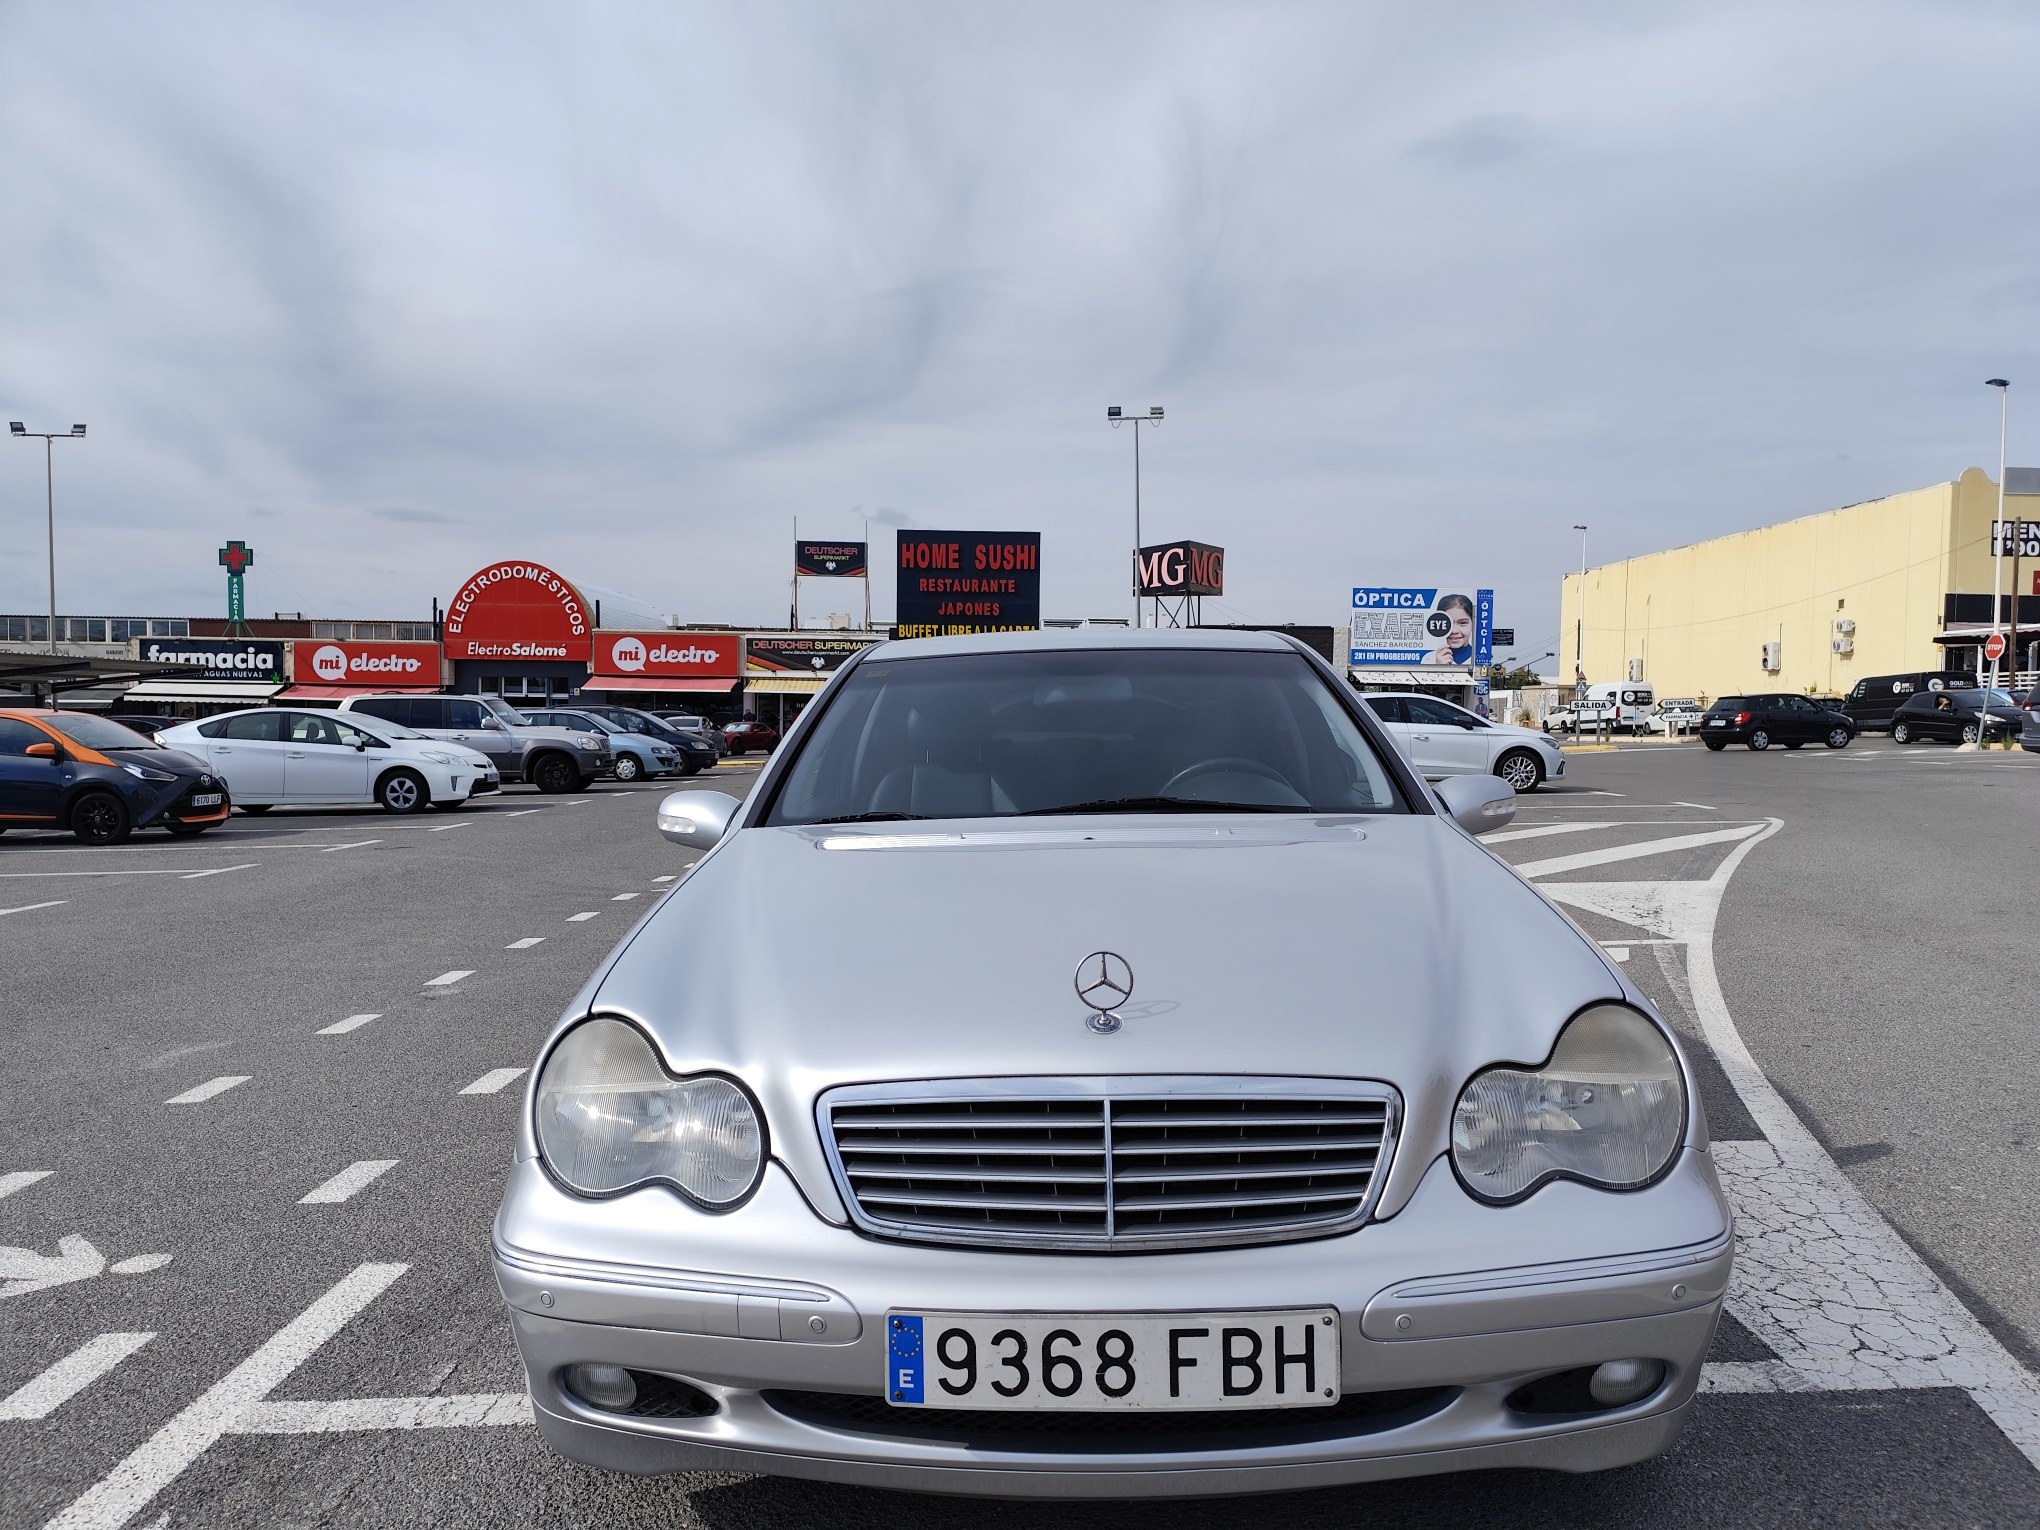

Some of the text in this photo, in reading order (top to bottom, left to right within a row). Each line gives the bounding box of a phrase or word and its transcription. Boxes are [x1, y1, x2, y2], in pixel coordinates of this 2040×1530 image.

[804, 546, 858, 555] DEUTSCHER
[901, 543, 1036, 570] HOME SUSHI
[1138, 547, 1187, 589] MG
[1189, 547, 1223, 588] MG
[919, 578, 1016, 593] RESTAURANTE
[232, 578, 240, 621] FARMACIA
[449, 565, 585, 636] ELECTRODOMÉSTICOS
[1354, 589, 1426, 607] ÓPTICA
[938, 602, 1000, 617] JAPONES
[898, 624, 939, 639] BUFFET
[1429, 620, 1448, 630] EYE
[467, 641, 567, 657] ElectroSalomé
[618, 643, 720, 664] mi electro
[752, 640, 873, 651] DEUTSCHER SUPERMAR
[1987, 643, 2002, 651] STOP
[147, 644, 274, 670] farmacia
[319, 652, 422, 673] mi electro
[1375, 653, 1421, 661] PROGRESIVOS
[203, 670, 230, 678] AGUAS
[1574, 701, 1607, 709] SALIDA
[936, 1324, 1316, 1398] 9368 FBH
[899, 1369, 915, 1389] E
